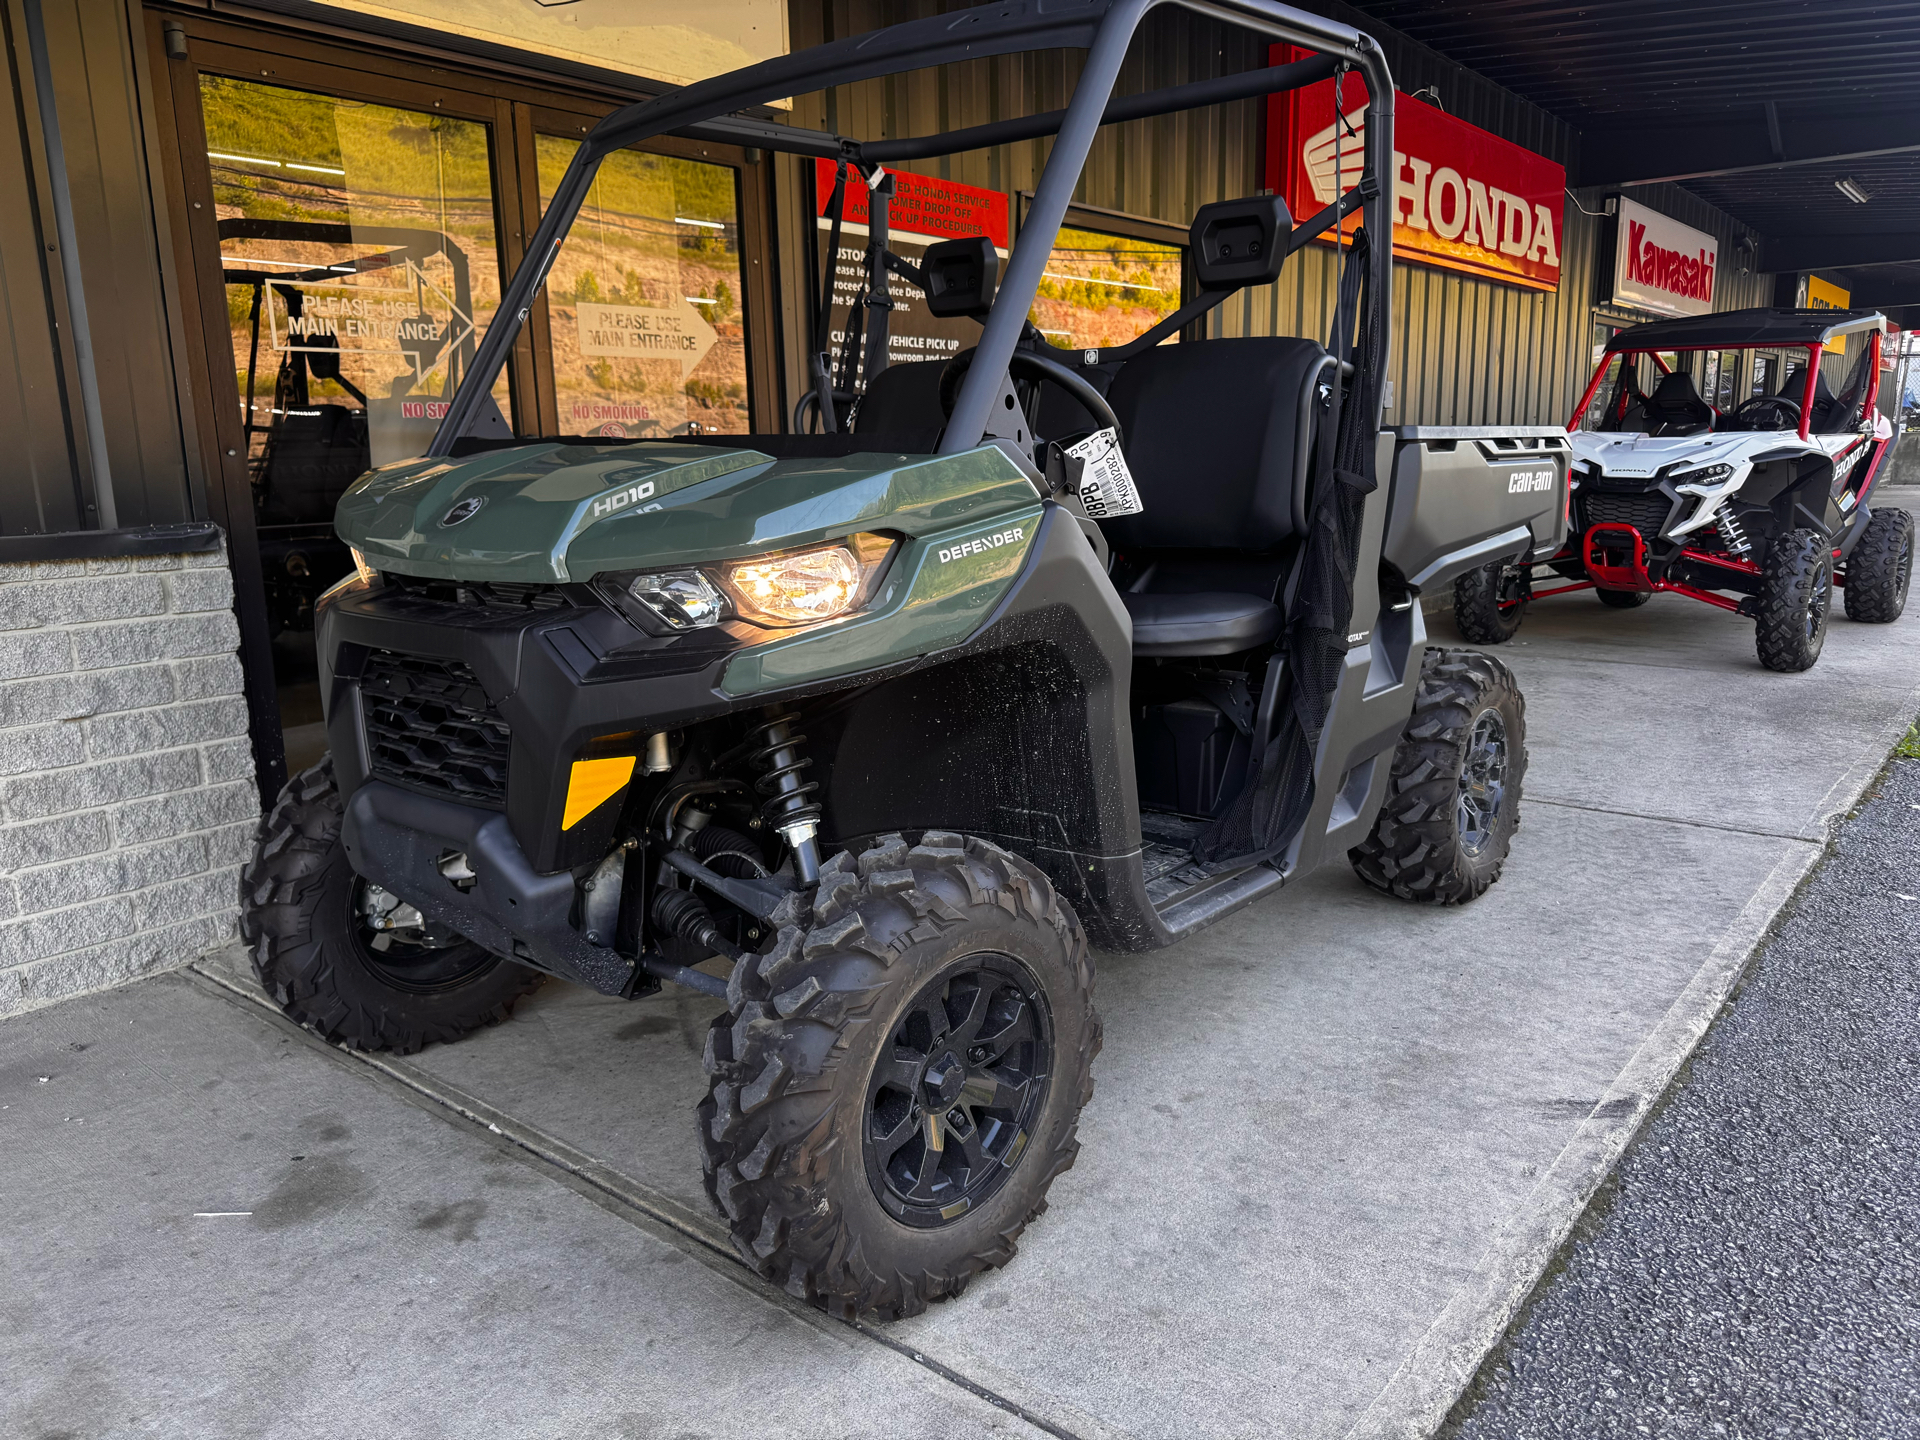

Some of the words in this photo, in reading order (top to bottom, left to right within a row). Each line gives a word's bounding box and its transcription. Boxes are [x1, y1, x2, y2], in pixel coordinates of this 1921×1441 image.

[866, 191, 922, 210] COMER
[925, 202, 951, 215] DROP
[954, 207, 972, 220] OFF
[914, 183, 951, 201] HONDA
[954, 192, 991, 209] SERVICE
[1393, 150, 1559, 267] HONDA
[852, 203, 869, 216] AN
[889, 210, 904, 222] CK
[906, 213, 919, 224] UP
[922, 216, 983, 235] PROCEDURES
[835, 265, 856, 277] ease
[1626, 219, 1714, 303] Kawasaki
[832, 292, 845, 305] he
[887, 285, 904, 297] vice
[302, 294, 374, 318] PLEASE
[382, 301, 419, 319] USE
[288, 316, 339, 337] MAIN
[346, 319, 441, 341] ENTRANCE
[599, 312, 651, 331] PLEASE
[656, 316, 682, 333] USE
[588, 330, 625, 347] MAIN
[629, 333, 697, 351] ENTRANCE
[926, 338, 946, 350] PICK
[947, 340, 960, 351] UP
[401, 402, 424, 419] NO
[572, 405, 590, 420] NO
[593, 405, 650, 420] SMOKING
[1833, 440, 1872, 481] HONDA
[1508, 470, 1553, 494] can-am
[593, 481, 655, 517] HD10
[1080, 482, 1107, 517] 8BPB
[938, 527, 1024, 564] DEFENDER
